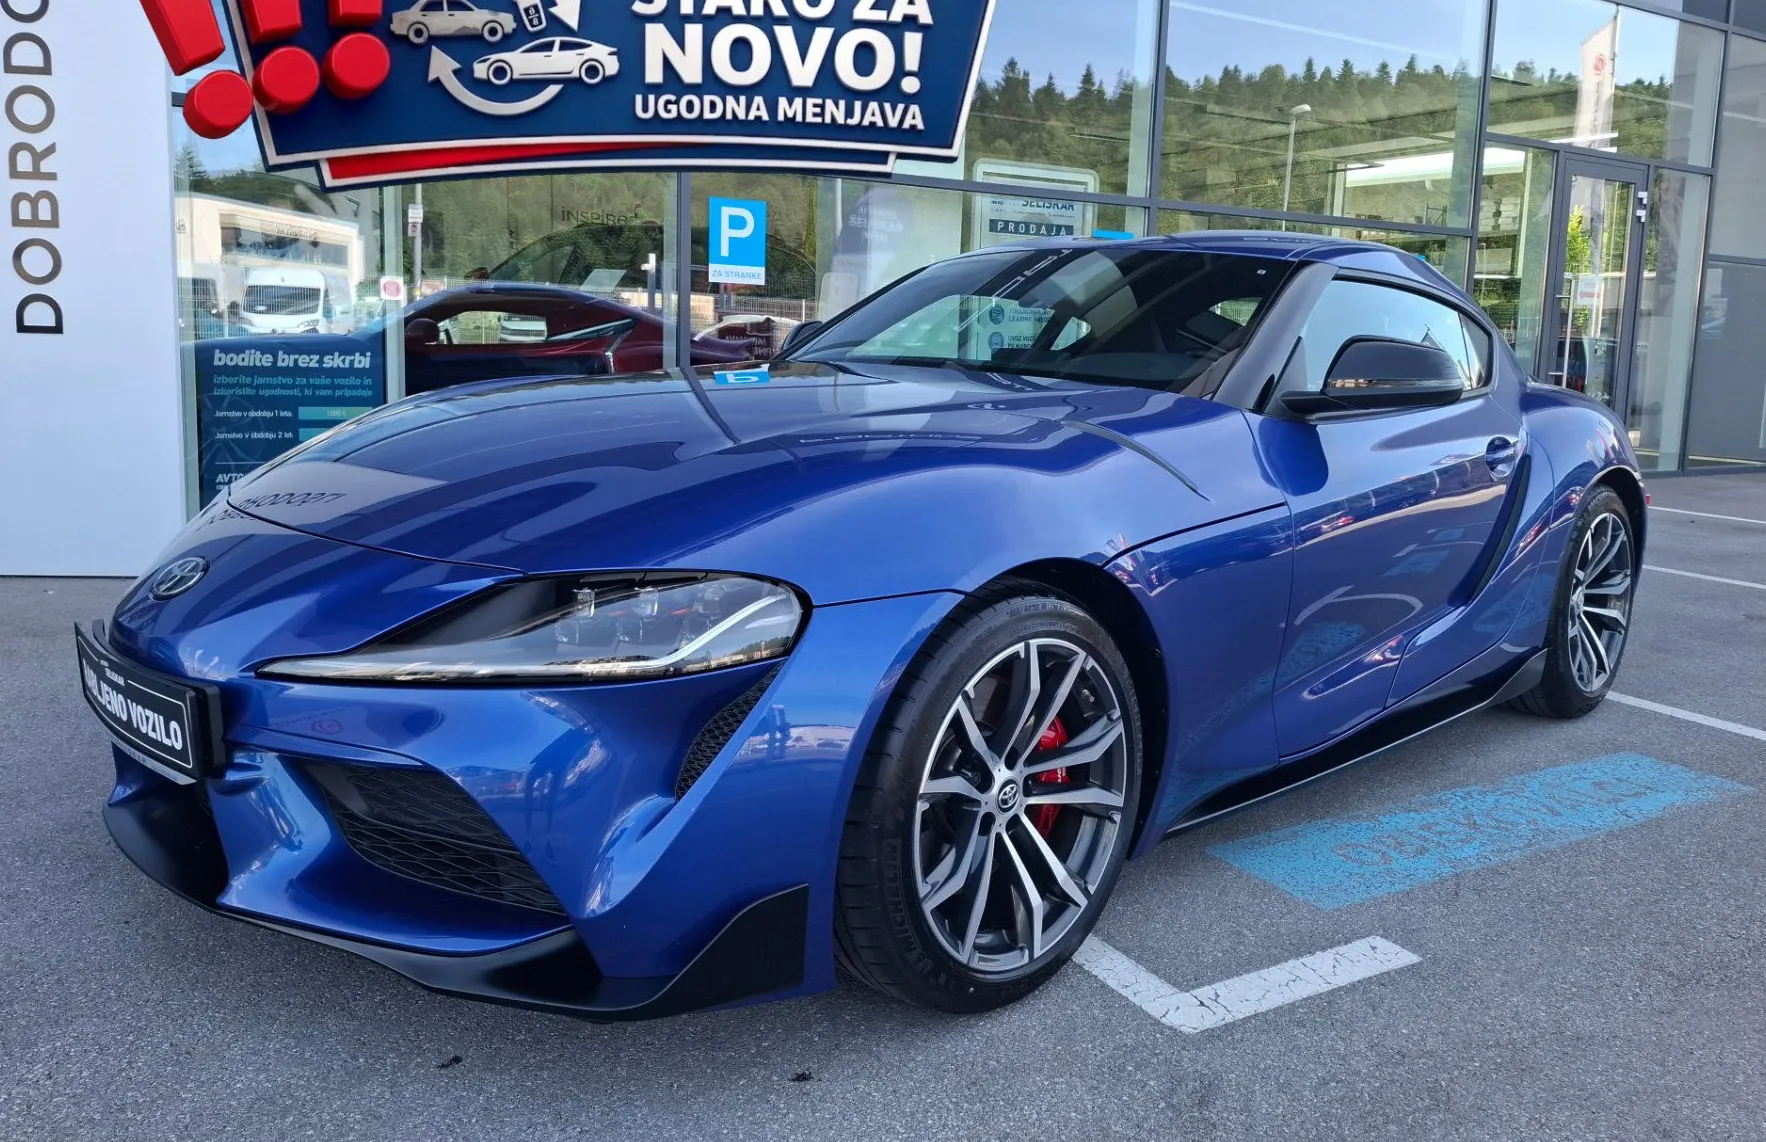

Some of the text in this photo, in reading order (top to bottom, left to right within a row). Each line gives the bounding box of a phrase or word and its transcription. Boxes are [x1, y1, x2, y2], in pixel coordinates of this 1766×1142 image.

[720, 206, 755, 257] P
[997, 221, 1067, 236] PRODAJA
[711, 270, 762, 280] ZA STRANKE
[213, 349, 372, 369] bodite brez skrbi
[213, 374, 372, 386] izberite jamstvo za vaše vozilo in
[259, 387, 301, 397] ugodnosti,
[304, 387, 313, 396] ki
[315, 388, 333, 396] vam
[334, 387, 373, 398] pripadajo
[214, 409, 242, 418] Jamstvo
[248, 410, 274, 419] obdobju
[215, 431, 243, 439] Jamstvo
[251, 431, 276, 440] obdobju
[127, 698, 183, 751] VOZILO
